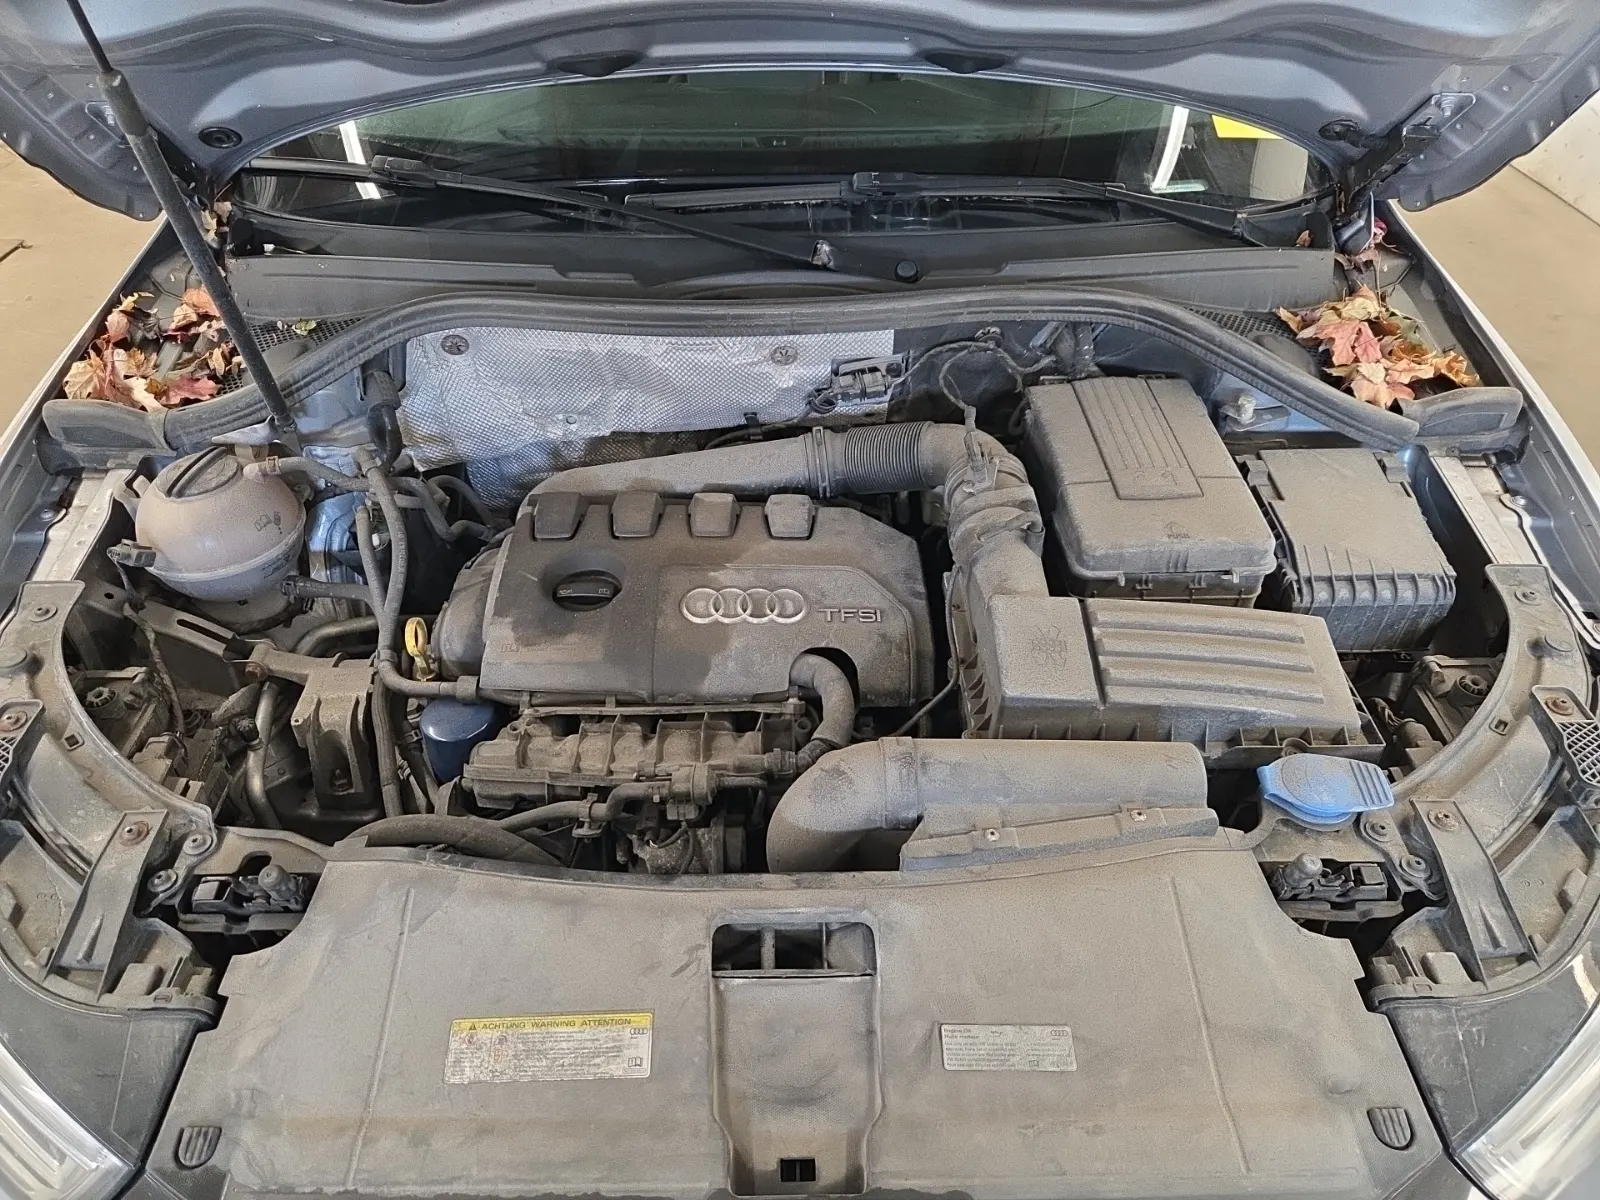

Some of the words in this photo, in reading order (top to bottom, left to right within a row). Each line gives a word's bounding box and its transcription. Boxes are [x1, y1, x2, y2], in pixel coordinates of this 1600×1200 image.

[817, 608, 882, 622] TFSI
[481, 1021, 526, 1030] ACHTUNG
[531, 1020, 576, 1028] WARNING
[581, 1018, 632, 1027] ATTENTION
